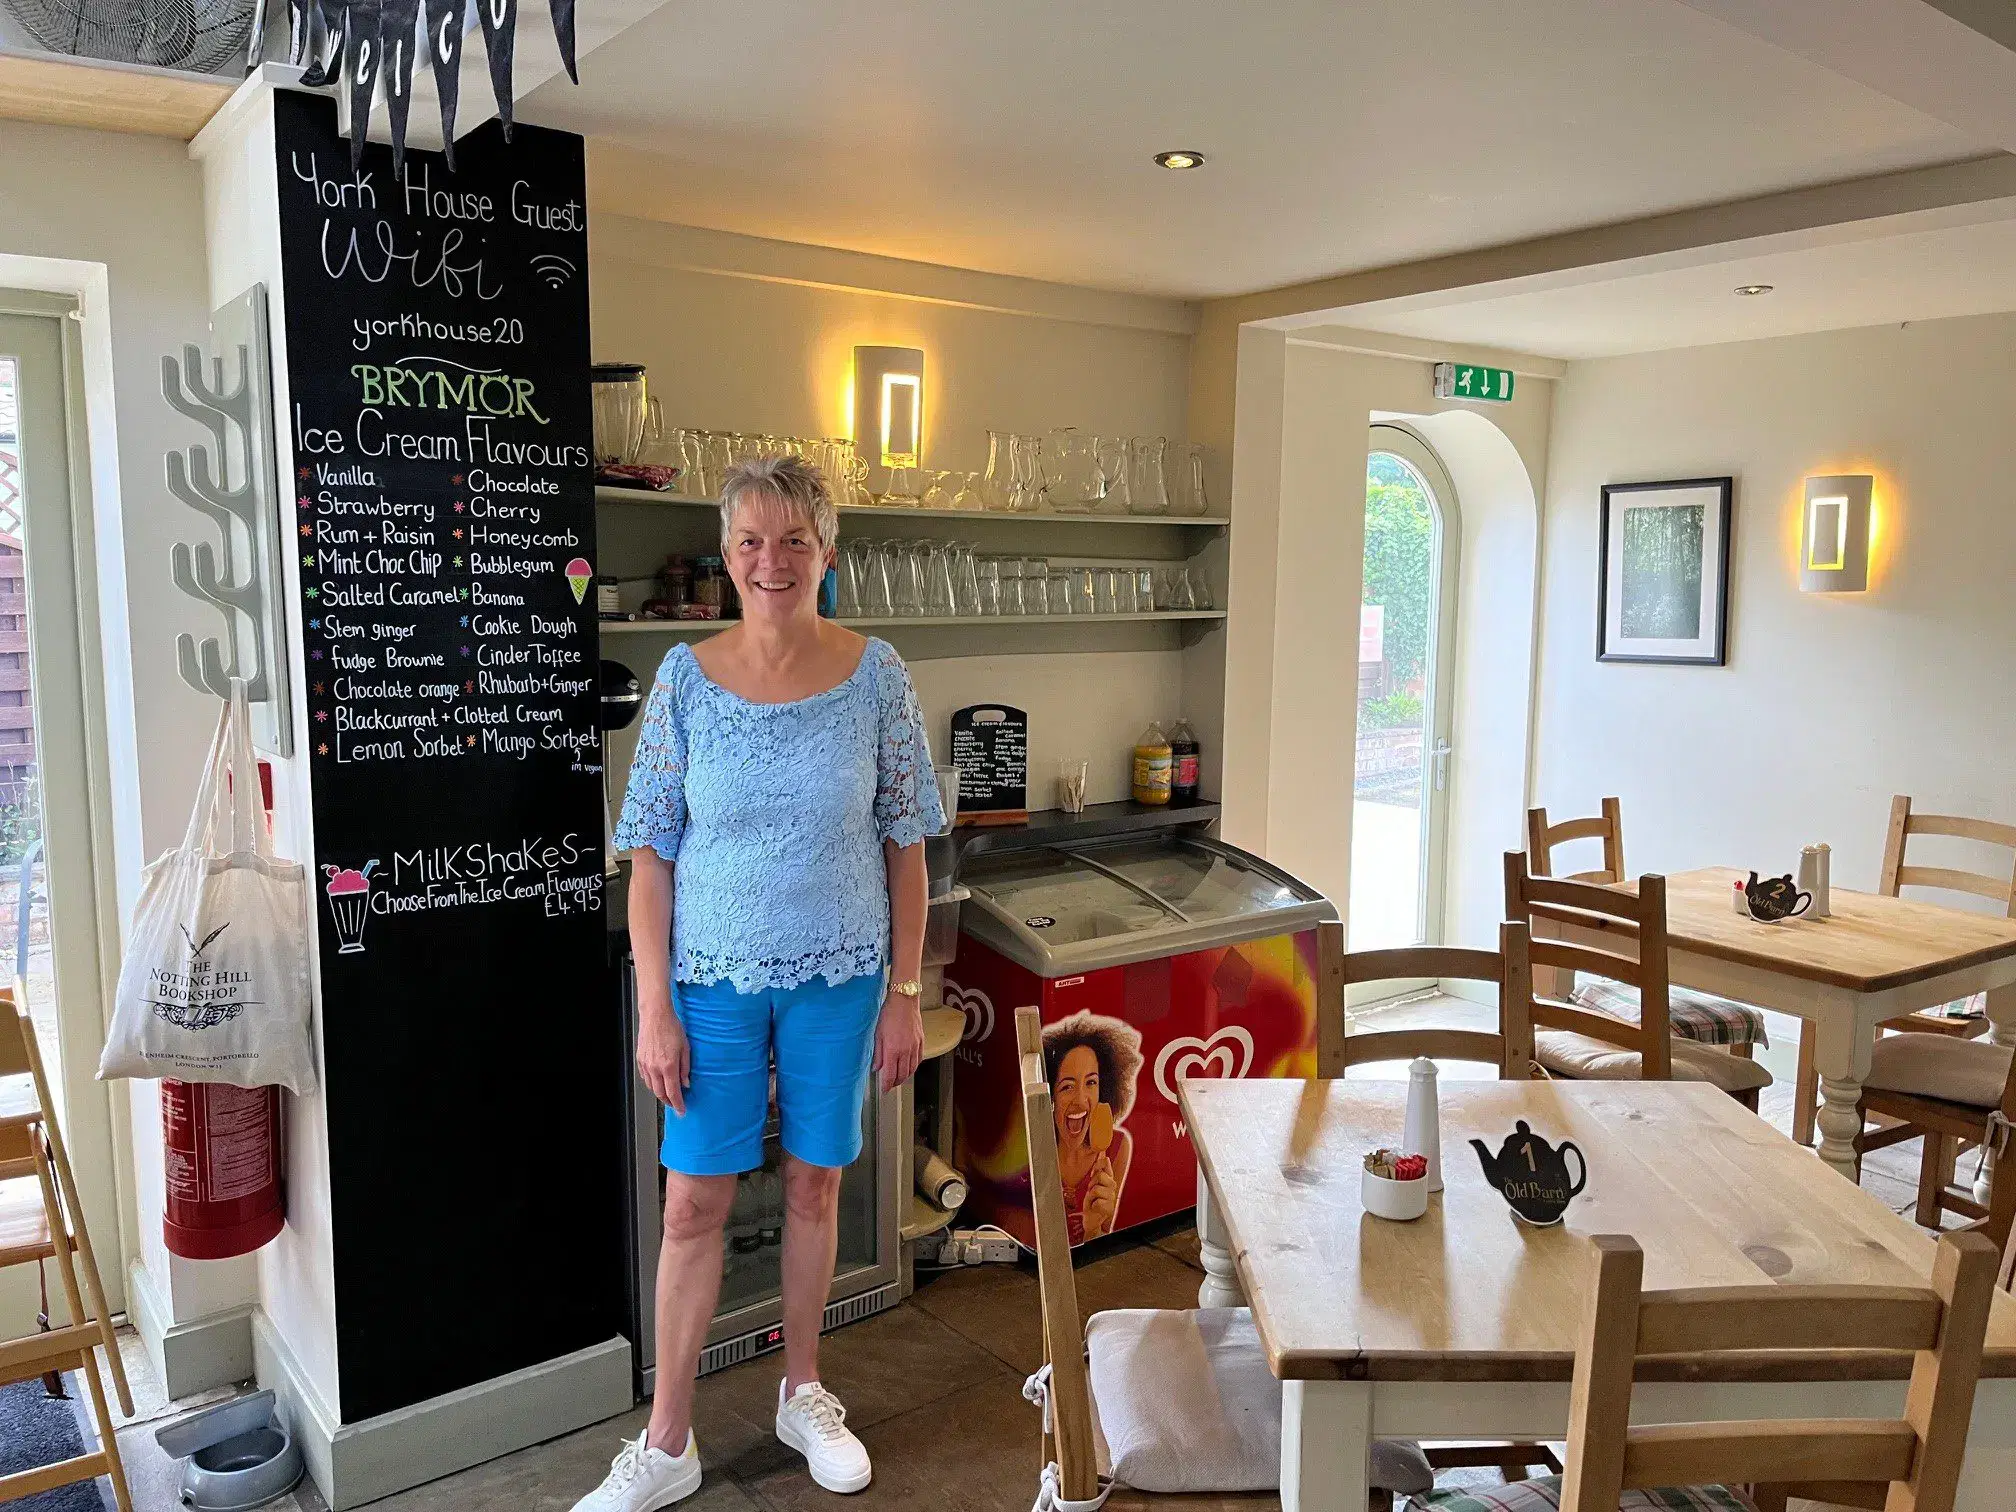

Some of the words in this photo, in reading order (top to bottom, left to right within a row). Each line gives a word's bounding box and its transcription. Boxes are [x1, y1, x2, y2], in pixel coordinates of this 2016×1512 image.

[293, 151, 376, 209] York
[405, 162, 495, 222] House
[511, 180, 584, 232] Guest
[321, 218, 503, 300] Wifi
[350, 364, 551, 425] BRYMOR
[296, 402, 345, 453] Ice
[356, 408, 462, 462] Cream
[466, 415, 589, 467] Flavours
[317, 463, 375, 486] Vanilla
[468, 469, 559, 494] Chocolate
[317, 491, 434, 522] Strawberry
[471, 497, 539, 523] Cherry
[317, 520, 358, 543] Rum
[363, 531, 377, 543] +
[383, 520, 434, 545] Raisin
[471, 525, 578, 549] Honeycomb
[319, 549, 362, 574] Mint
[366, 549, 405, 574] Choc
[409, 550, 441, 578] Chip
[471, 553, 554, 578] Bubblegum
[323, 581, 384, 606] Salted
[390, 583, 461, 605] Caramel
[472, 582, 525, 605] Banana
[324, 615, 364, 639] Stem
[371, 624, 416, 642] ginger
[473, 615, 521, 635] Cookie
[531, 615, 577, 638] Dough
[386, 647, 444, 667] Brownie
[477, 647, 529, 667] Cinder
[528, 643, 582, 667] Toffee
[334, 676, 412, 700] Chocolate
[419, 685, 459, 703] orange
[336, 706, 438, 732] Blackcurrant
[442, 713, 450, 721] +
[455, 705, 509, 724] Clotted
[517, 705, 562, 722] Cream
[336, 733, 405, 762] Lemon
[413, 728, 465, 757] Sorbet
[482, 728, 536, 760] Mango
[540, 725, 600, 750] Sorbet
[371, 890, 427, 915] Choose
[427, 884, 458, 909] From
[455, 881, 477, 904] The
[475, 879, 502, 903] Ice
[503, 875, 545, 900] Cream
[546, 870, 602, 895] Flavours
[1769, 883, 1786, 900] 2
[150, 967, 210, 988] NOTTING
[215, 971, 252, 985] HILL
[159, 984, 237, 1002] BOOKSHOP
[139, 1050, 174, 1059] ENHEIM
[955, 1047, 983, 1067] ALL'S
[1520, 1141, 1536, 1172] 1
[1505, 1182, 1528, 1200] Old
[1529, 1181, 1565, 1199] Barn
